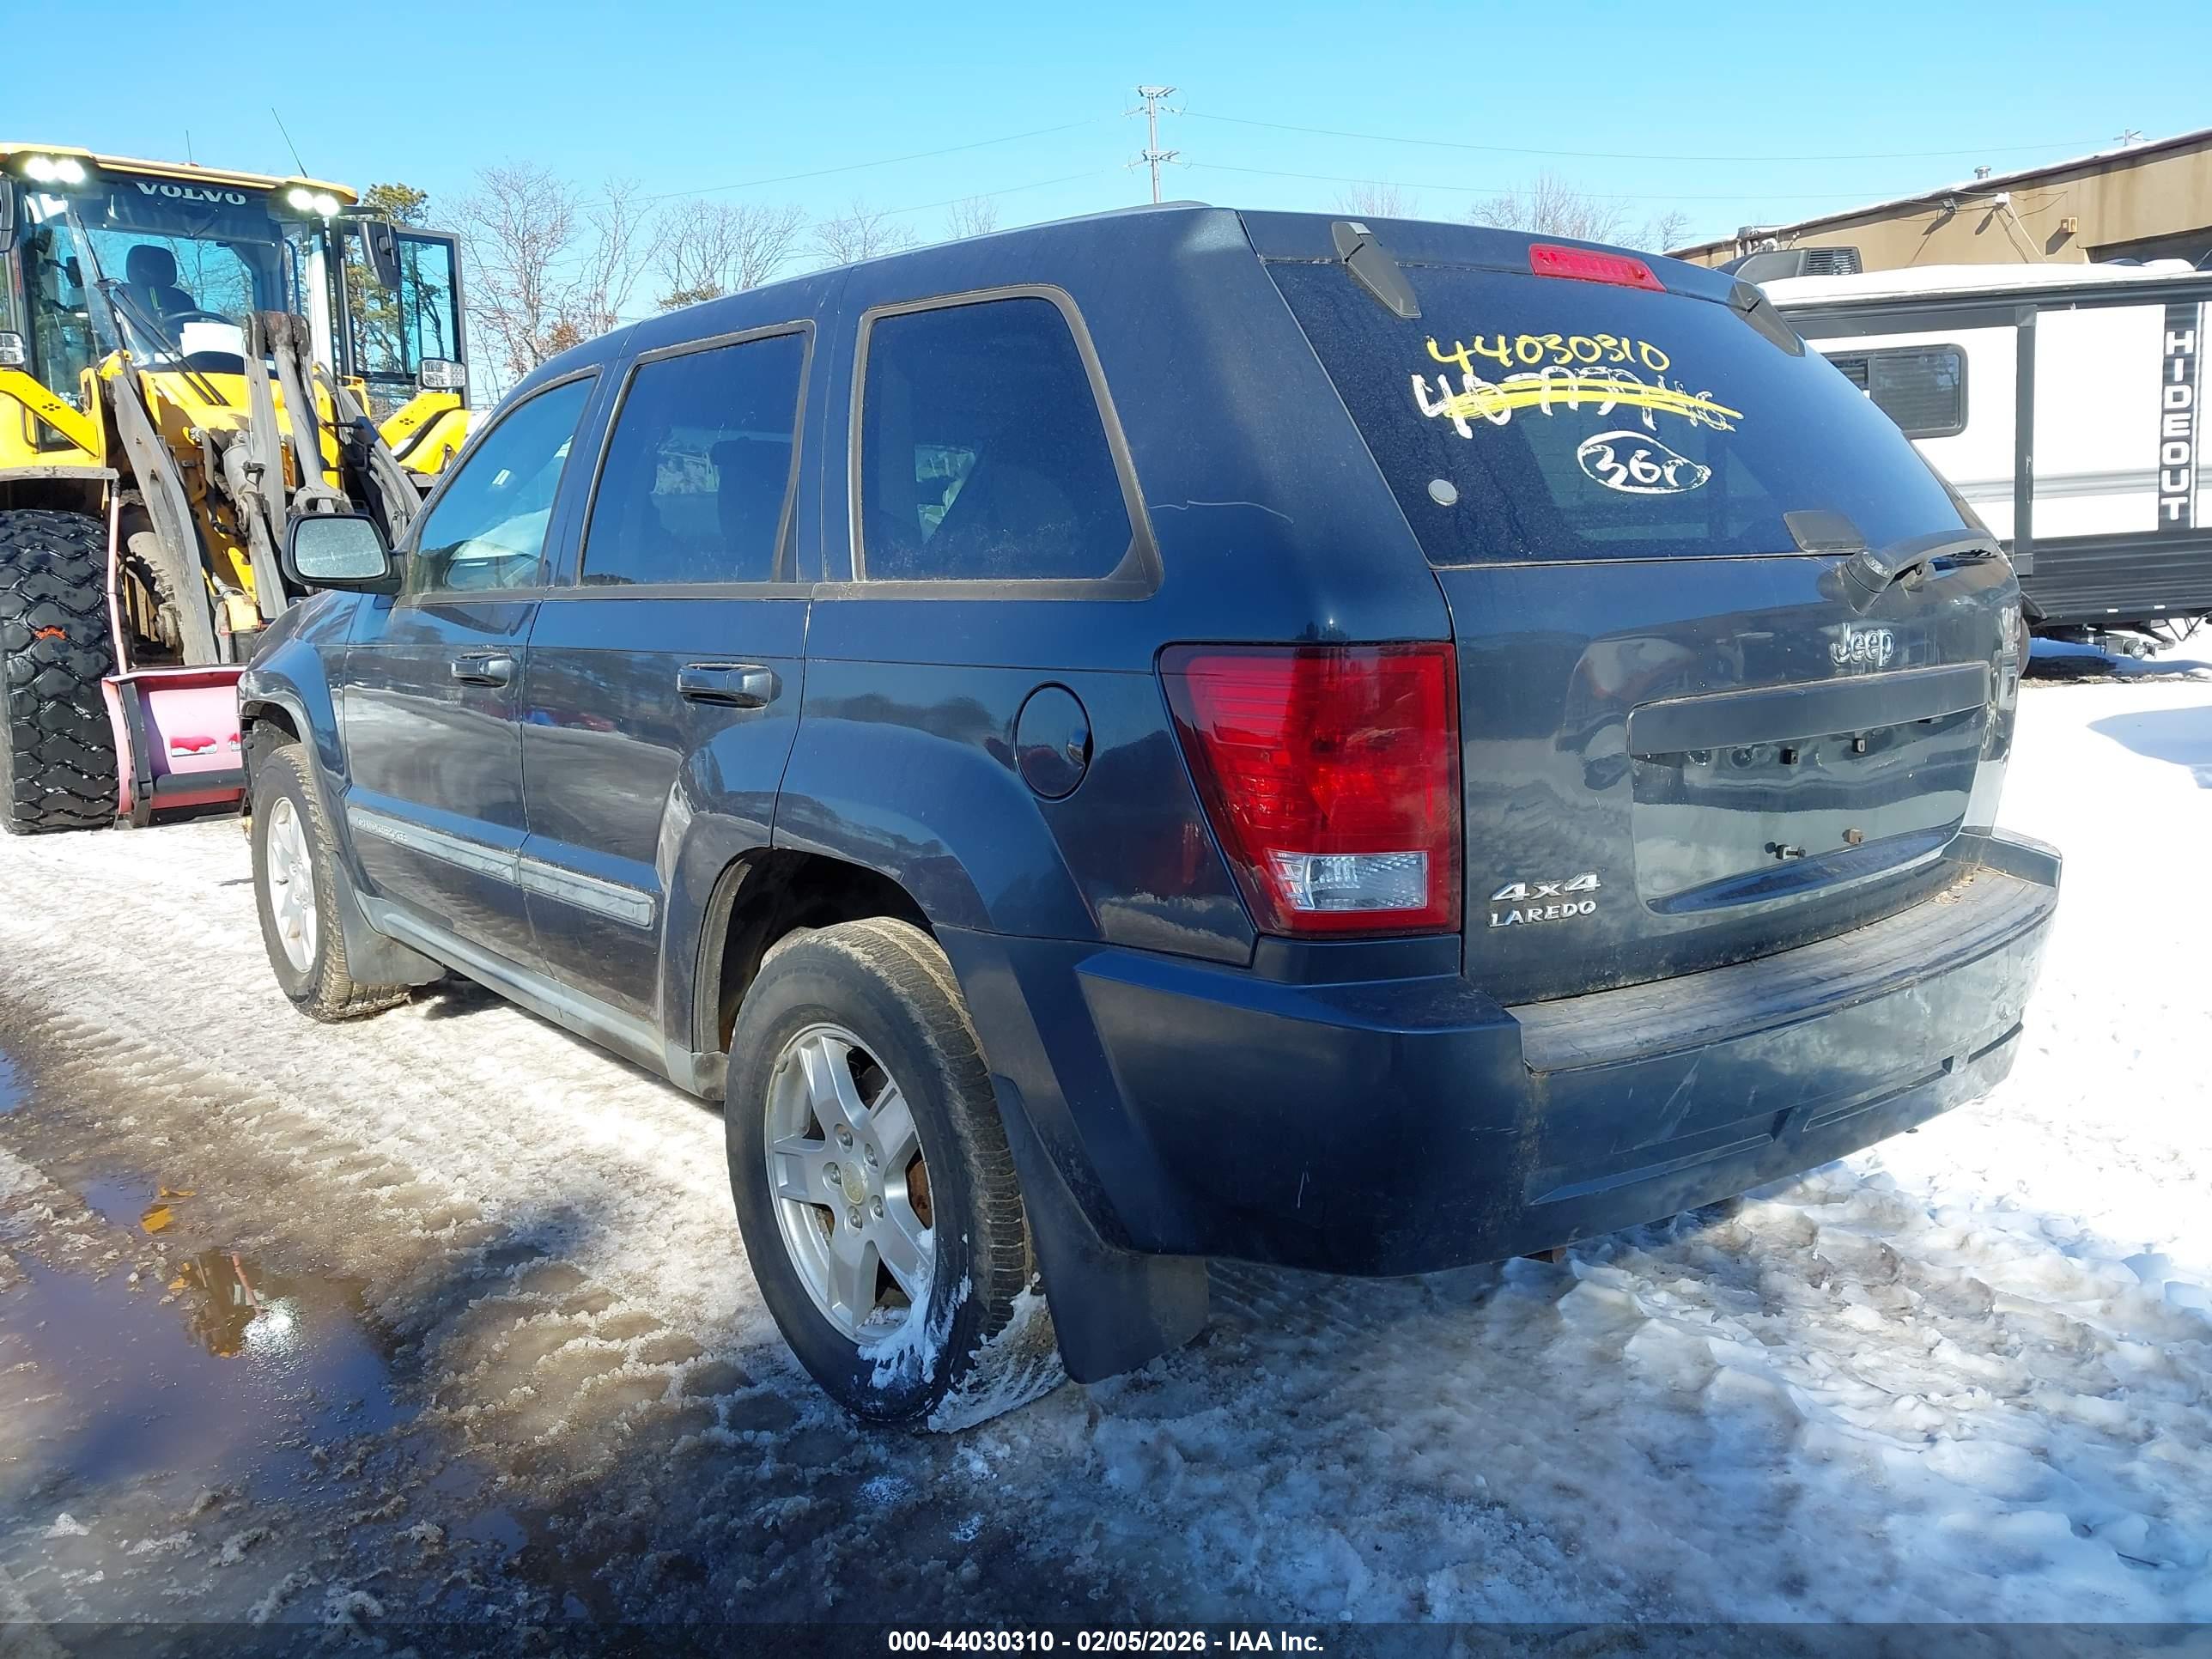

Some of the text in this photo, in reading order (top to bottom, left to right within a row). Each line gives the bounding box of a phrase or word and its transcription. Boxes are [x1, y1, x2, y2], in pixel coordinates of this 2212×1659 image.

[136, 182, 246, 205] VOLVO
[1425, 333, 1671, 374] 44030310
[2160, 330, 2195, 521] HIDEOUT
[1829, 623, 1895, 667] Jeep
[1488, 900, 1597, 928] LAREDO
